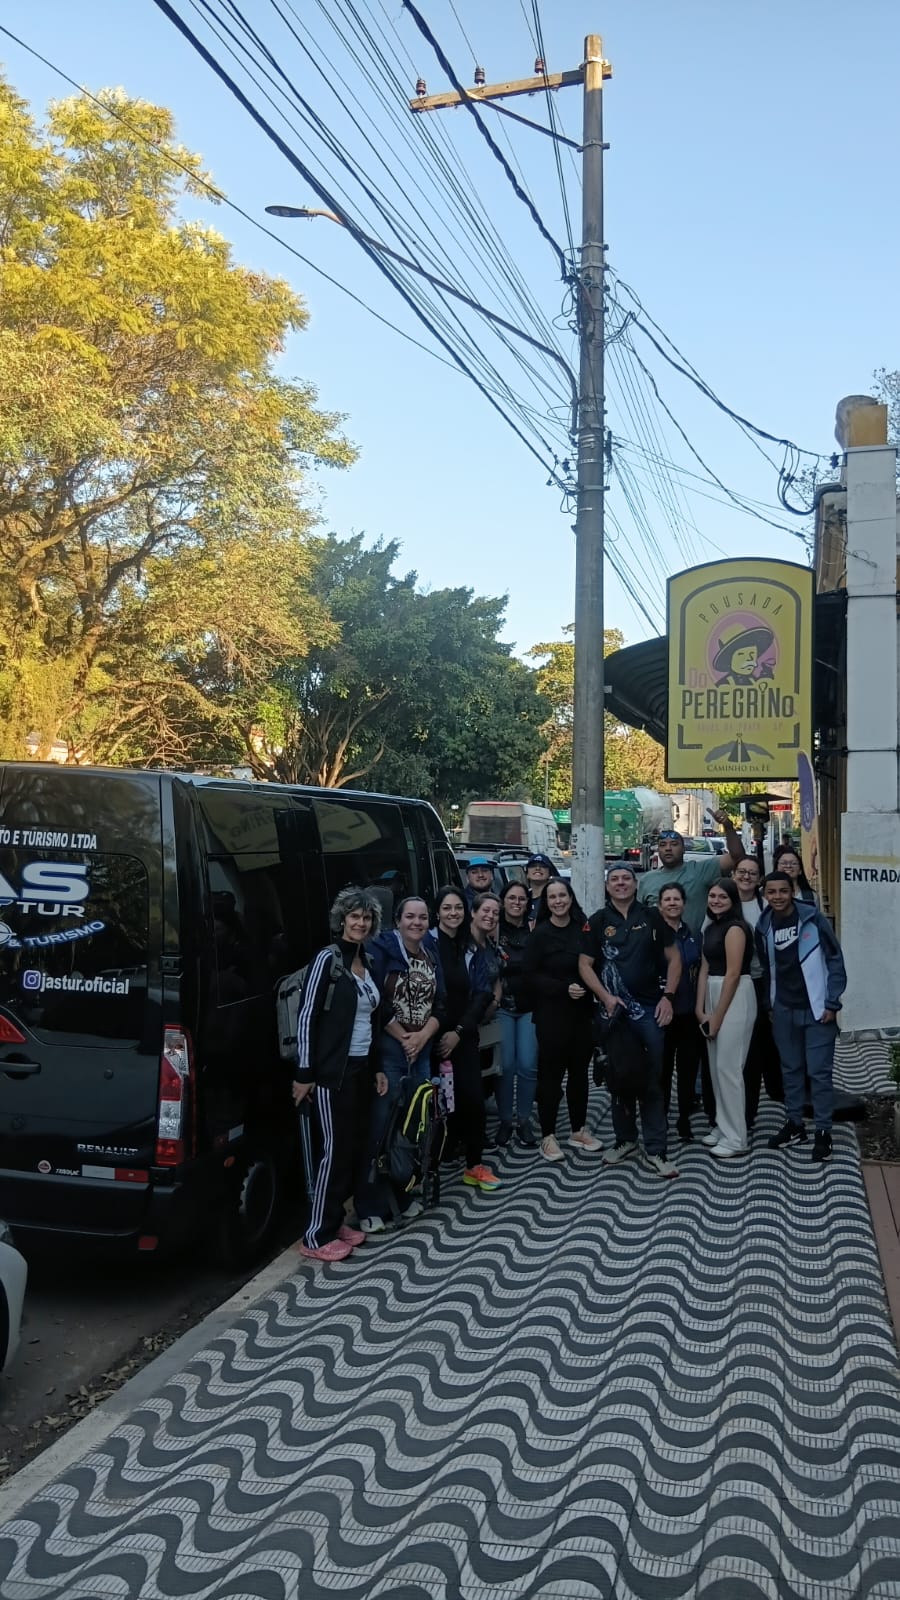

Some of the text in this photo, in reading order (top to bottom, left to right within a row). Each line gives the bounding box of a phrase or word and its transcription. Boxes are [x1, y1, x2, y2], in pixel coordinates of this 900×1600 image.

[698, 592, 783, 623] POUSADA
[706, 764, 747, 772] CAMINHO
[12, 830, 20, 845] E
[22, 831, 69, 848] TURISMO
[70, 833, 97, 850] LTDA
[16, 901, 86, 918] TUR
[24, 921, 105, 946] TURISMO
[775, 926, 797, 943] NIKE
[40, 973, 129, 995] jastur.oficial
[77, 1143, 138, 1156] RENAULT
